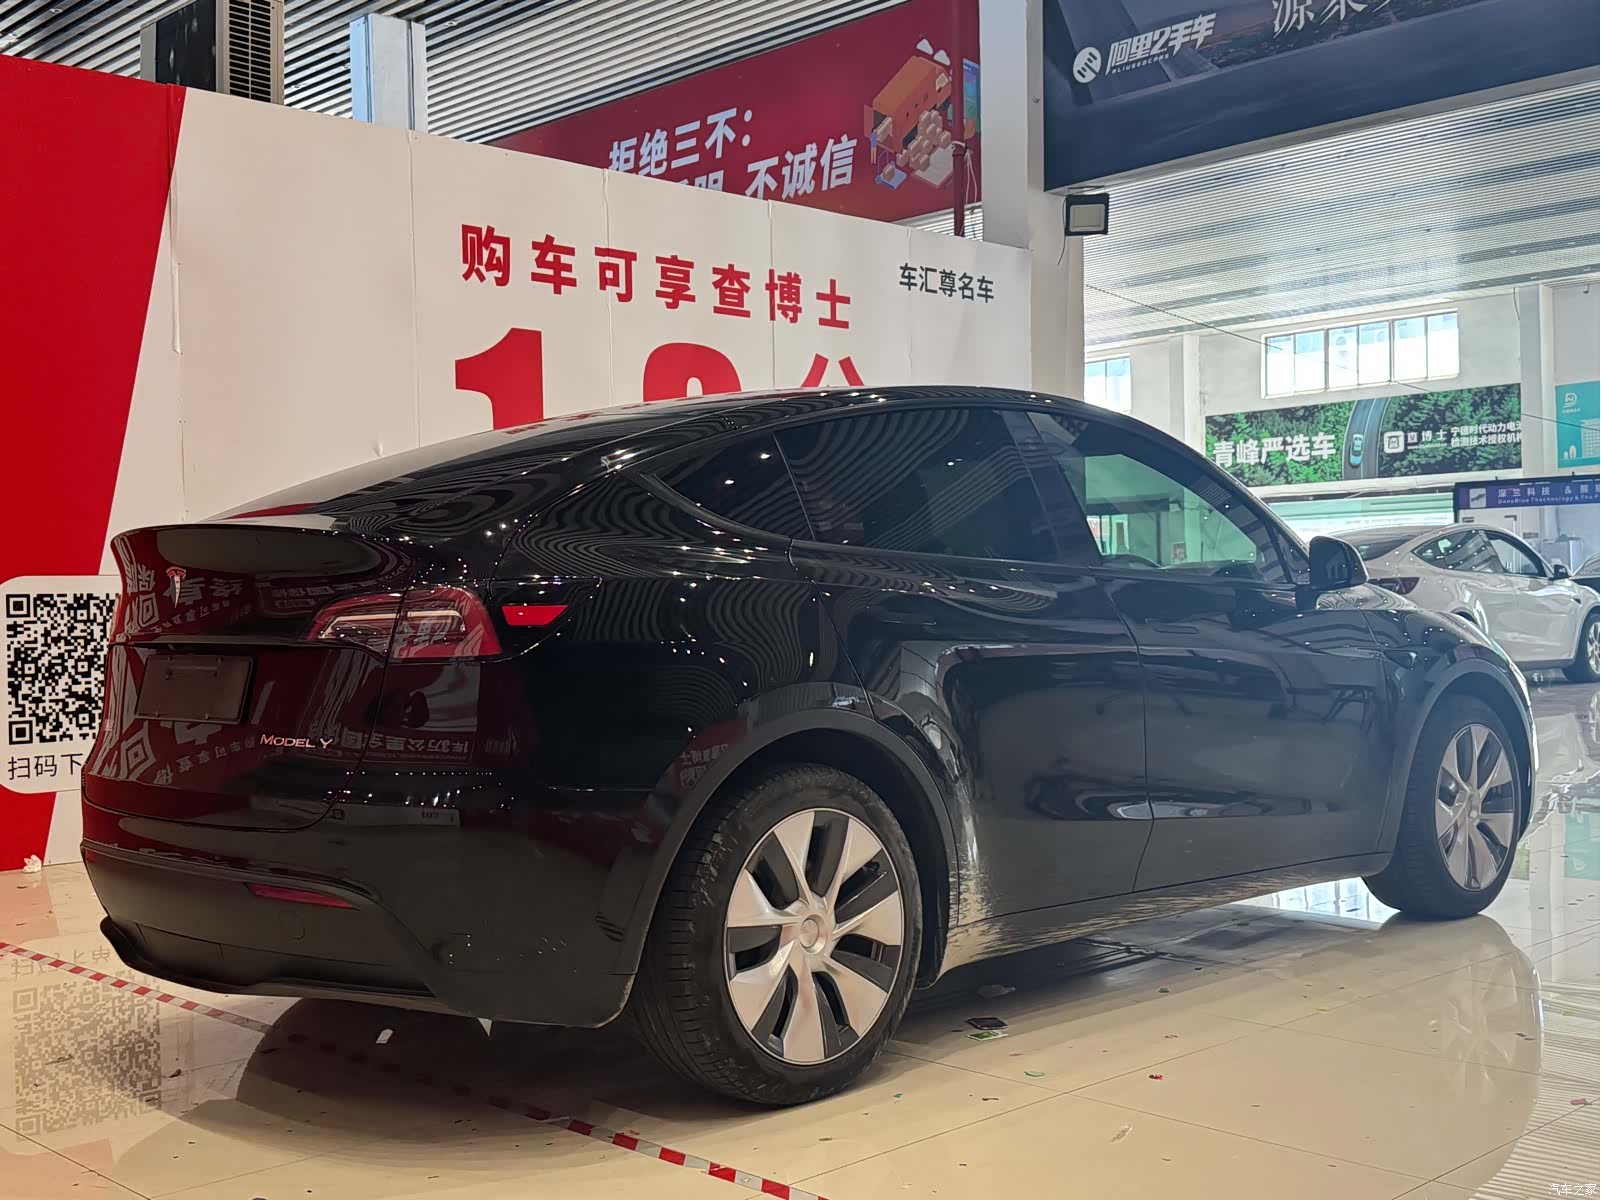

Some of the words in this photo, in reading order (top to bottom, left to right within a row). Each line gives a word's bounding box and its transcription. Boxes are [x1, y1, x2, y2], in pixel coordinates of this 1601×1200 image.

[1105, 12, 1217, 76] 阿里2手车
[745, 134, 858, 200] 不诚信
[461, 223, 851, 330] 购车可享查博士
[899, 262, 995, 304] 车汇尊名车
[1213, 431, 1337, 468] 青峰严选车
[260, 733, 316, 749] MODEL
[319, 737, 334, 750] Y
[7, 752, 84, 781] 扫码下
